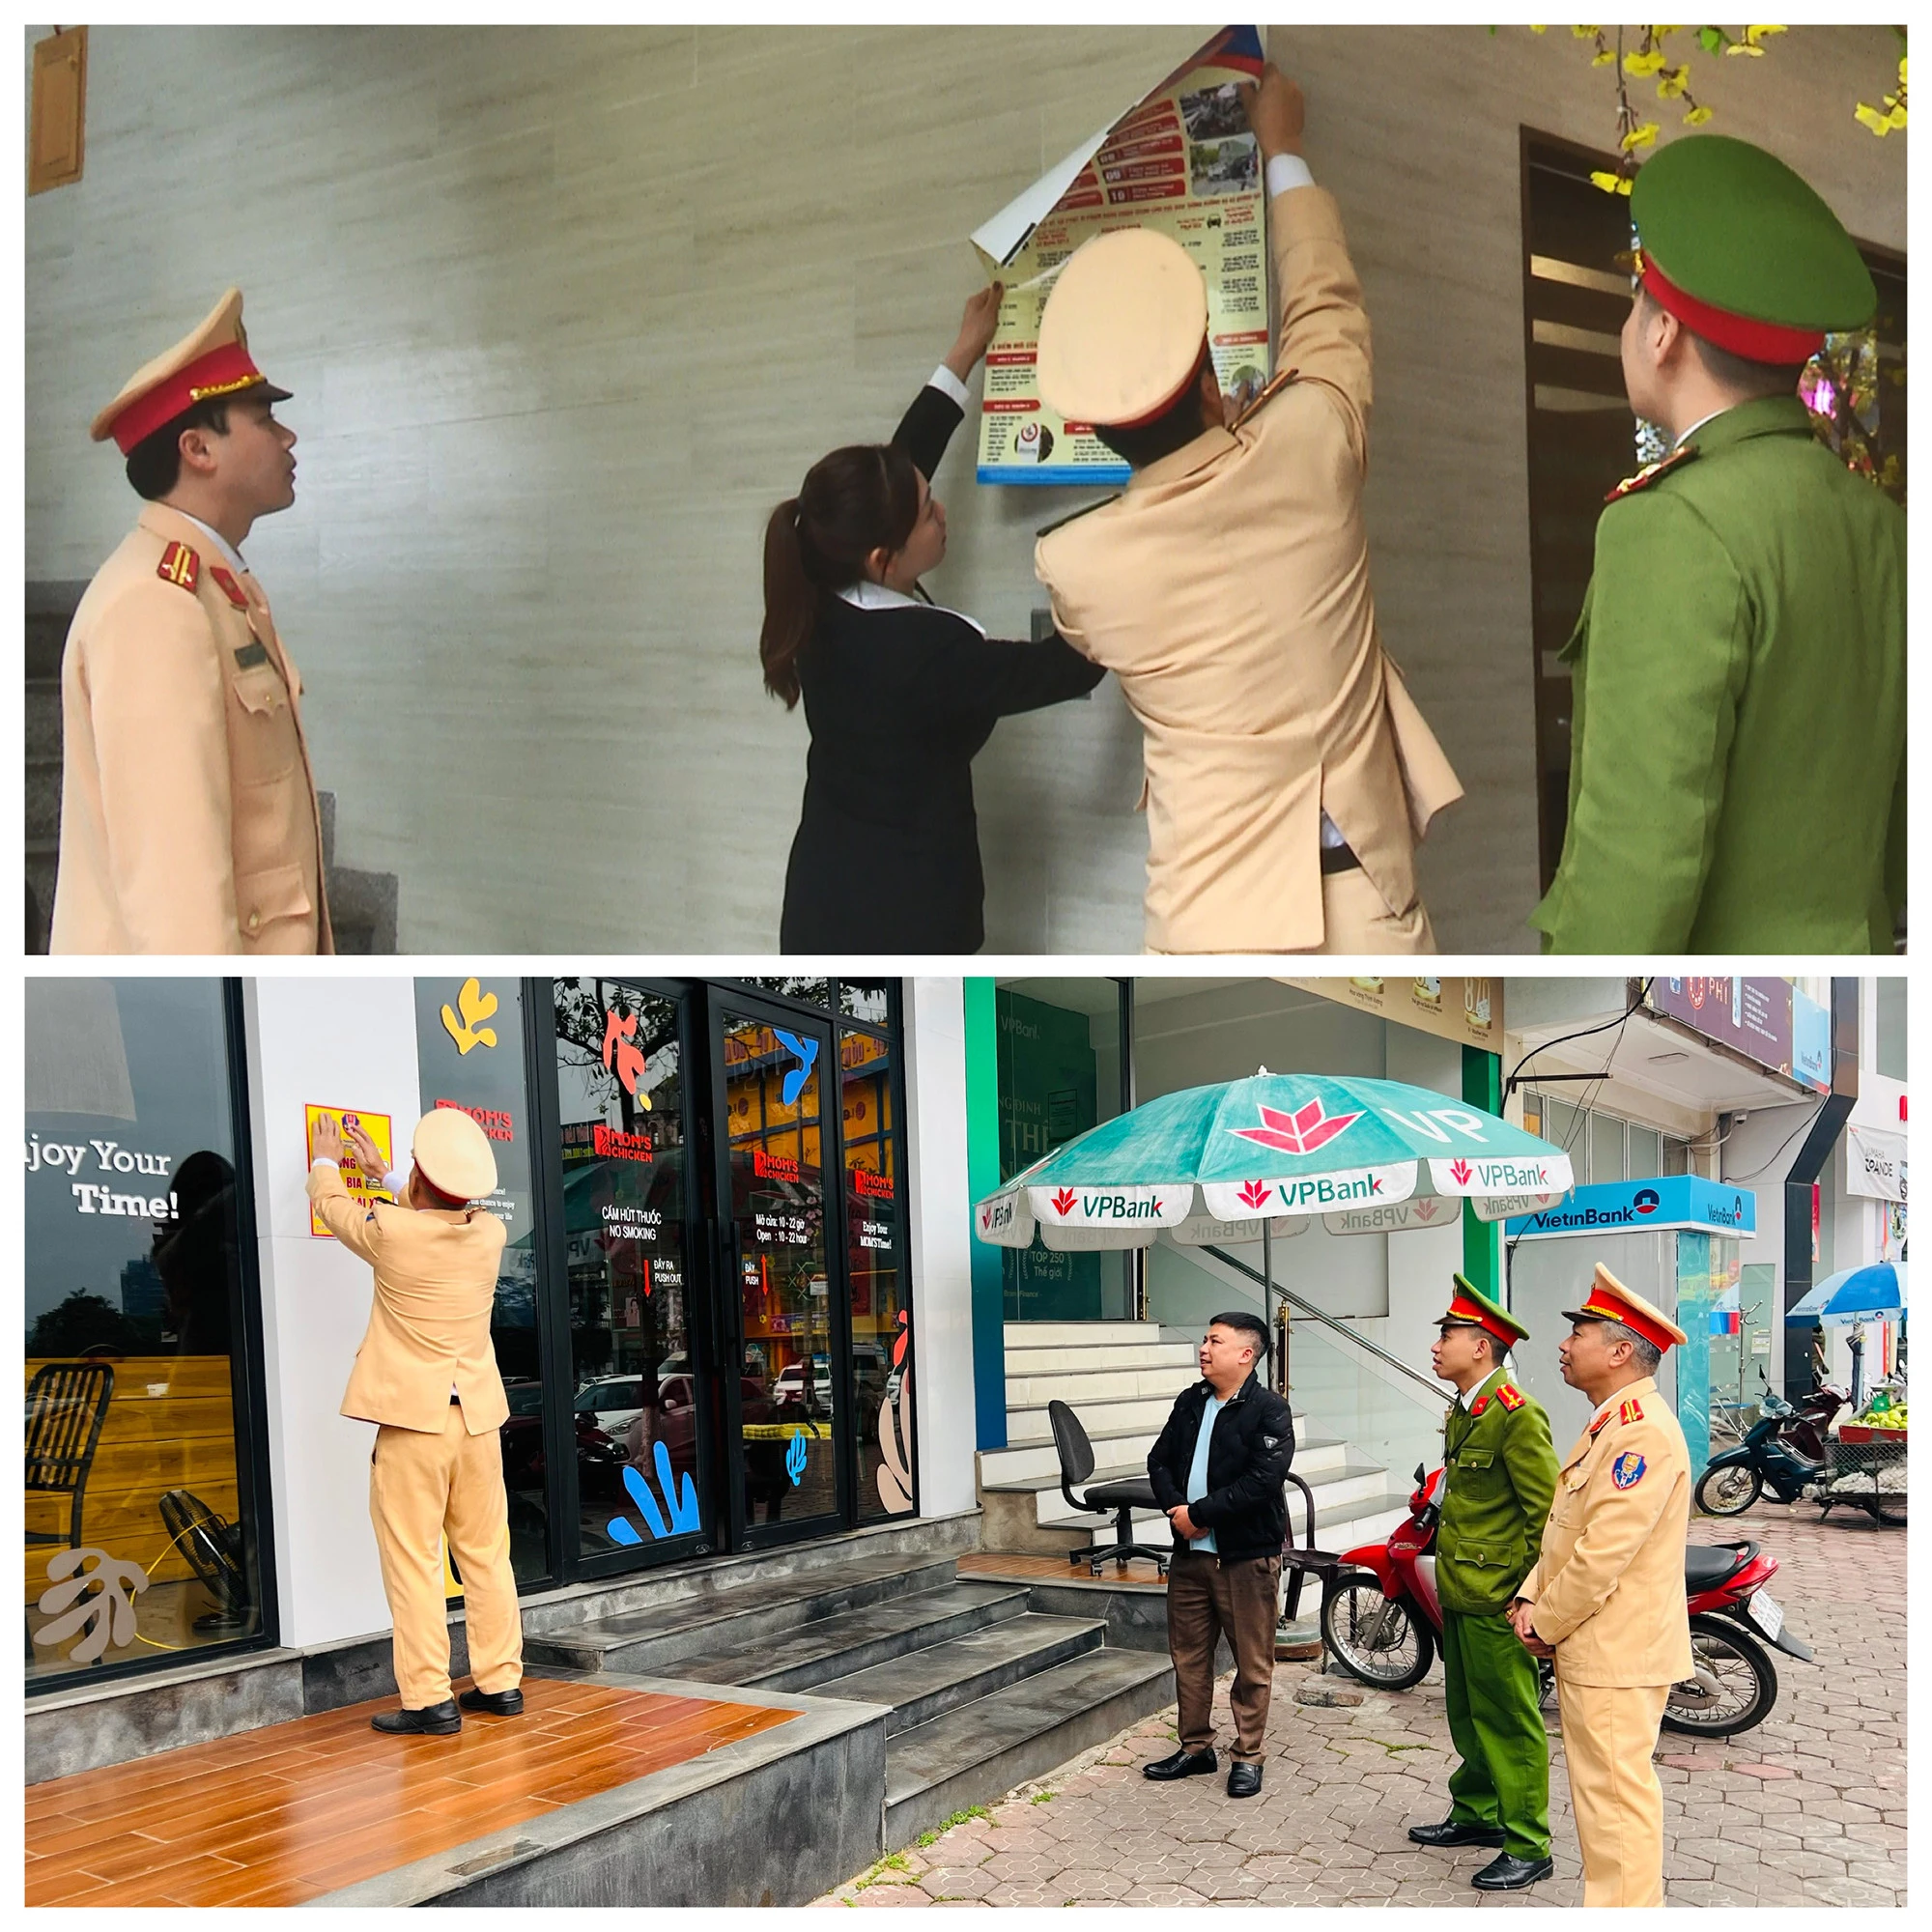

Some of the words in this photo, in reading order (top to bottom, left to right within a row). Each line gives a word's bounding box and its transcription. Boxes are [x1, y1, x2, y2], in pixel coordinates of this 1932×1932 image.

[1112, 189, 1125, 202] 10
[1379, 1107, 1491, 1144] VP
[89, 1138, 172, 1177] Your
[611, 1146, 653, 1163] CHICKEN
[339, 1157, 356, 1170] NG
[346, 1177, 362, 1189] BIA
[767, 1169, 800, 1184] CHICKEN
[1477, 1164, 1549, 1187] VPBank
[866, 1186, 895, 1200] CHICKEN
[1278, 1174, 1385, 1207] VPBank
[71, 1182, 180, 1220] Time!
[1083, 1195, 1164, 1219] VPBank
[619, 1207, 636, 1222] HÚT
[636, 1208, 662, 1225] THUỐC
[1533, 1206, 1634, 1229] VietinBank
[1707, 1203, 1736, 1226] VietinBank
[779, 1216, 785, 1228] 10
[788, 1217, 796, 1229] 22
[863, 1221, 877, 1236] Enjoy
[876, 1223, 889, 1236] Your
[609, 1224, 621, 1238] NO
[622, 1225, 657, 1241] SMOKING
[756, 1229, 772, 1243] Open
[779, 1231, 785, 1242] 10
[788, 1232, 796, 1243] 22
[796, 1233, 808, 1244] hour
[1031, 1250, 1048, 1263] TOP
[1049, 1251, 1065, 1264] 250
[666, 1260, 675, 1271] RA
[1034, 1265, 1048, 1277] Thế
[654, 1272, 670, 1283] PUSH
[669, 1273, 682, 1284] OUT
[745, 1275, 759, 1286] PUSH
